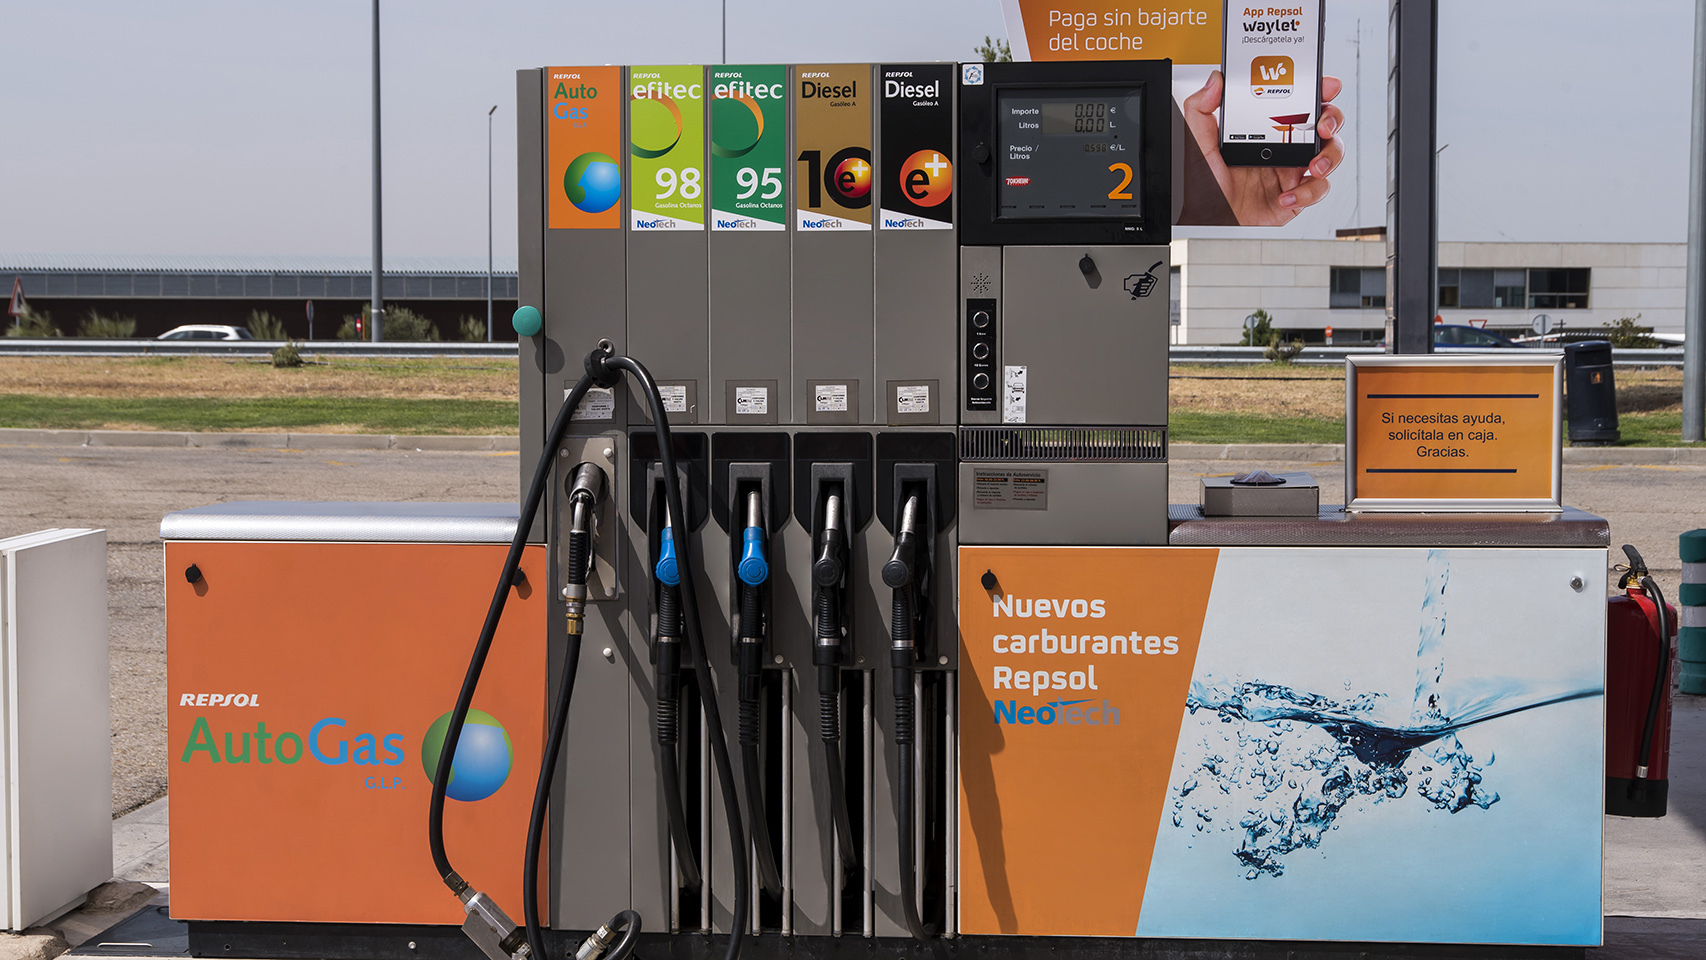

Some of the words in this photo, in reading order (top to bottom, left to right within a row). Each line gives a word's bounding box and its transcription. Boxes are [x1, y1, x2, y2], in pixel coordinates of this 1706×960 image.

[1049, 10, 1097, 31] Paga
[1104, 8, 1131, 26] sin
[1138, 8, 1207, 30] bajarte
[1243, 8, 1264, 18] App
[1267, 6, 1303, 18] Repsol
[1242, 19, 1298, 35] waylet
[1049, 33, 1079, 51] del
[1085, 32, 1142, 50] coche
[1242, 36, 1292, 44] ¡Descárgatela
[1294, 36, 1304, 44] ya!
[554, 82, 598, 99] Auto
[632, 81, 701, 99] efitec
[714, 81, 783, 99] efitec
[802, 80, 856, 98] Diesel
[885, 80, 940, 98] Diesel
[554, 102, 588, 119] Gas
[1074, 104, 1104, 118] 0,00
[1074, 118, 1104, 133] 0,00
[656, 167, 701, 200] 98
[736, 167, 782, 200] 95
[1108, 162, 1133, 200] 2
[637, 219, 676, 228] NeoTech
[717, 219, 756, 228] NeoTech
[803, 218, 842, 228] NeoTech
[885, 218, 924, 228] NeoTech
[1382, 412, 1394, 424] Si
[1398, 412, 1459, 424] necesitas
[1462, 412, 1505, 426] ayuda,
[1388, 429, 1444, 440] solicítala
[1448, 431, 1464, 440] en
[1468, 429, 1498, 443] caja.
[1416, 446, 1469, 457] Gracias.
[993, 594, 1106, 618] Nuevos
[993, 628, 1179, 655] carburantes
[994, 665, 1098, 696] Repsol
[180, 694, 260, 707] REPSOL
[994, 696, 1120, 726] NeoTech
[365, 776, 406, 789] G.L.P.
